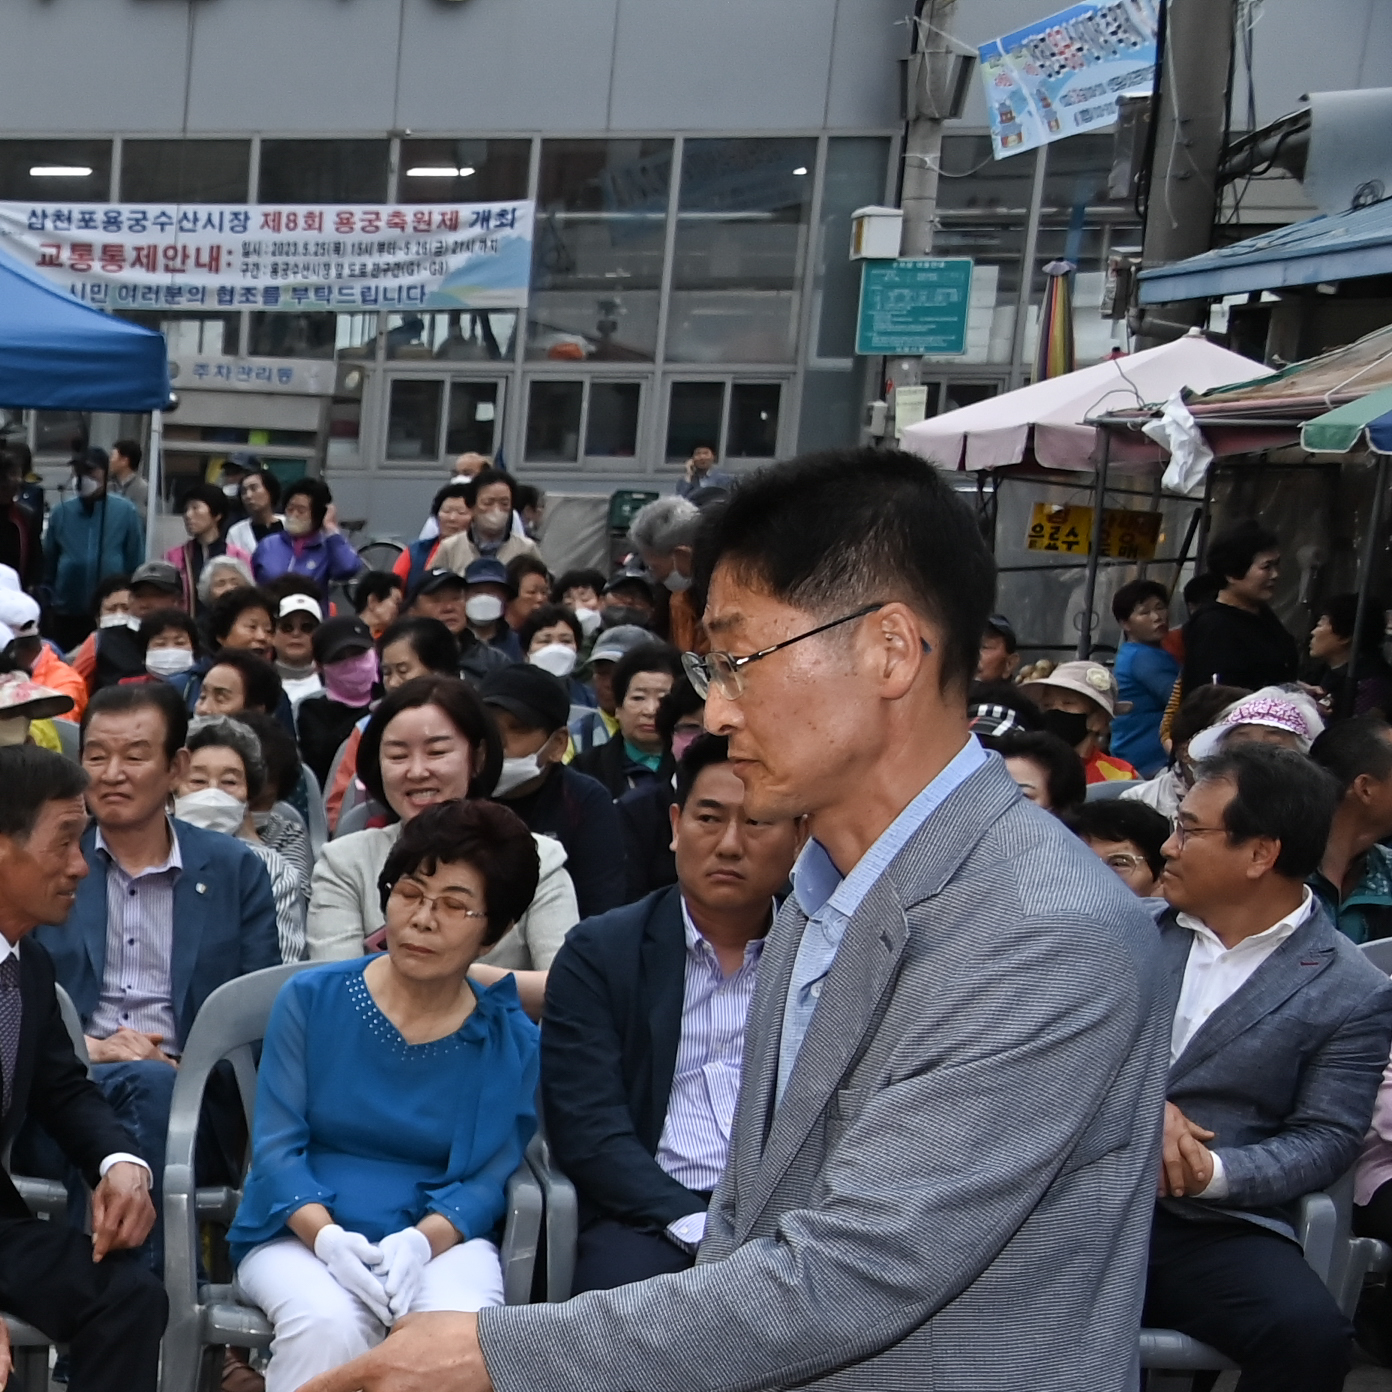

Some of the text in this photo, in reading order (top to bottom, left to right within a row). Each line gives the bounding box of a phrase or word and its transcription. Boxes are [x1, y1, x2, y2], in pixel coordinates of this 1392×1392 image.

[27, 208, 250, 233] 삼천포용궁수산시장
[259, 210, 324, 233] 제8회
[332, 210, 460, 233] 용궁축원제
[468, 207, 518, 231] 개최
[117, 283, 206, 306] 여러분의
[215, 284, 281, 307] 협조를
[290, 283, 427, 307] 부탁드립니다
